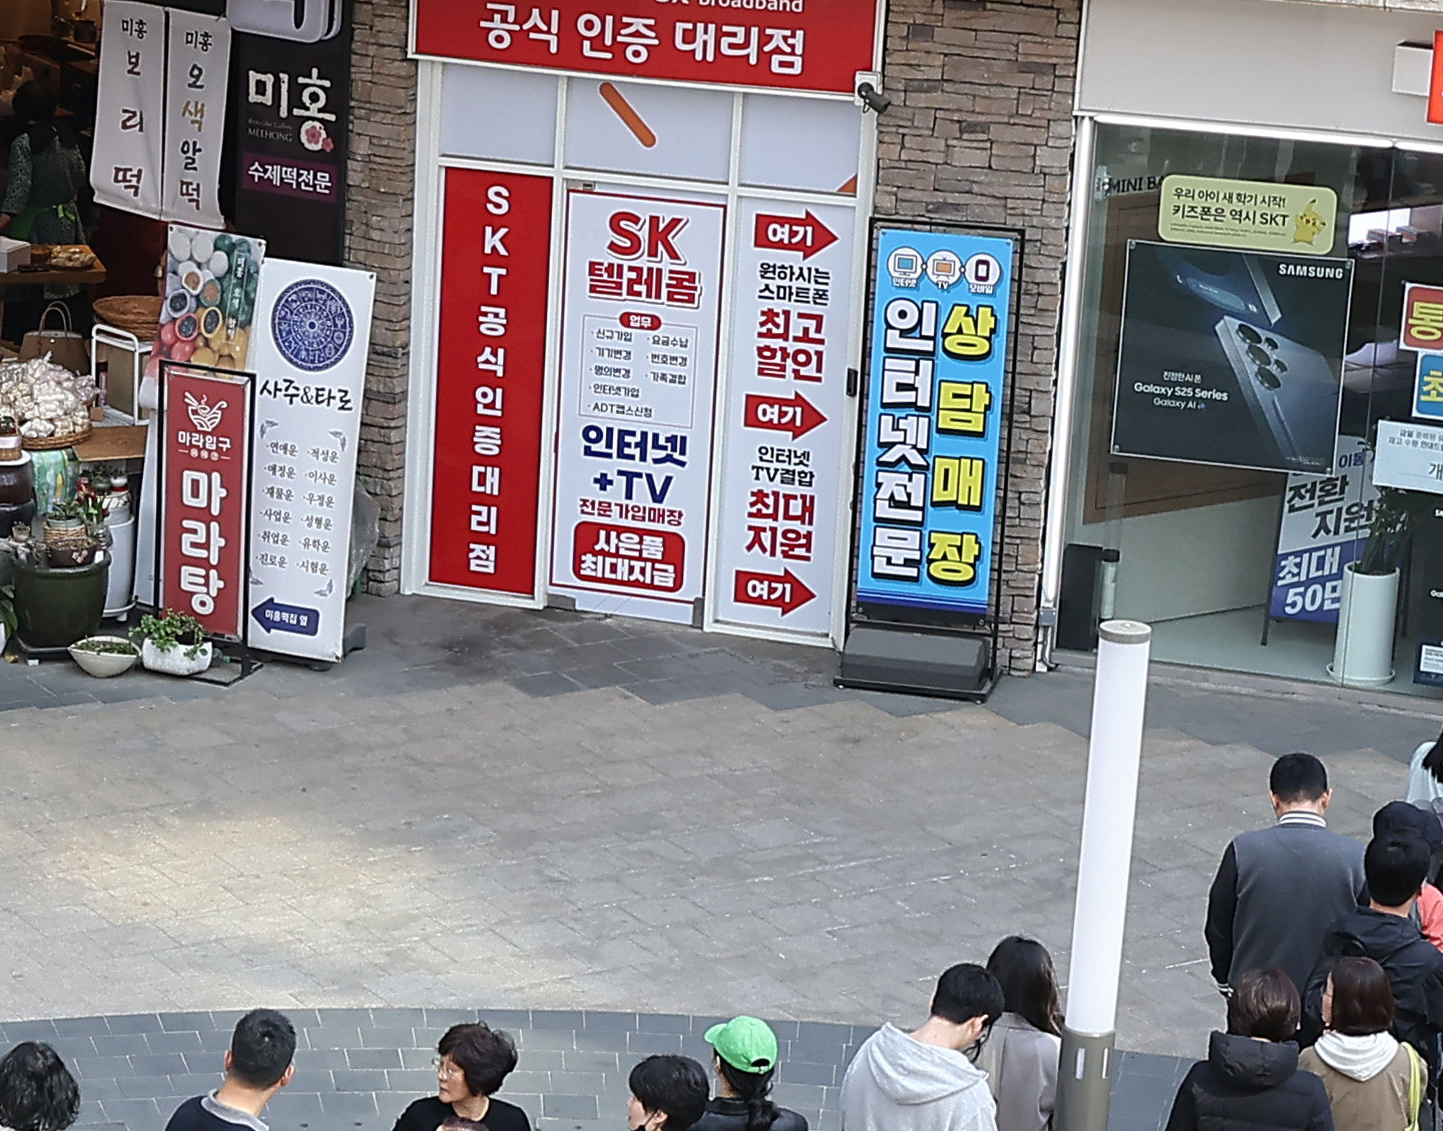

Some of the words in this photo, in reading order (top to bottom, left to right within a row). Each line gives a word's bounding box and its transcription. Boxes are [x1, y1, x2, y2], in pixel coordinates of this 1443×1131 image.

[122, 18, 147, 40] 미홍
[480, 3, 558, 54] 공식
[577, 12, 660, 64] 인증
[674, 21, 805, 75] 대리점
[185, 30, 213, 53] 미홍
[247, 67, 337, 151] 미홍
[248, 161, 333, 195] 수제떡전문
[1173, 188, 1195, 202] 우리
[1198, 190, 1219, 203] 아이
[1222, 192, 1233, 204] 새
[1236, 194, 1257, 206] 학기
[1260, 196, 1286, 208] 시작!
[1172, 204, 1226, 223] 키즈폰은
[1230, 209, 1256, 226] 역시
[1259, 214, 1289, 227] SKT
[607, 211, 688, 264] SK
[767, 223, 814, 247] 여기
[588, 261, 699, 305] 텔레콤
[759, 262, 830, 286] 원하시는
[892, 277, 916, 288] 인터넷
[1279, 263, 1344, 279] SAMSUNG
[758, 283, 829, 306] 스마트폰
[936, 281, 949, 290] TV
[630, 315, 652, 328] 업무
[757, 308, 826, 345] 최고
[596, 328, 633, 342] 신규가입
[652, 335, 689, 349] 요금수납
[595, 347, 632, 361] 기기변경
[651, 353, 688, 367] 번호변경
[756, 345, 824, 383] 할인
[594, 365, 631, 379] 명의변경
[650, 372, 687, 386] 가족결합
[260, 378, 354, 412] 사주&타로
[593, 384, 640, 398] 인터넷가입
[1134, 382, 1174, 399] Galaxy
[1175, 386, 1194, 397] S25
[1195, 388, 1229, 401] Series
[757, 404, 803, 427] 여기
[1153, 398, 1186, 410] Galaxy
[1187, 401, 1196, 409] AI
[178, 431, 231, 452] 마라입구
[582, 425, 688, 468] 인터넷
[873, 298, 939, 580] 인터넷전문
[928, 304, 996, 584] 상담매장
[758, 446, 811, 467] 인터넷
[593, 469, 674, 504] +TV
[752, 465, 815, 487] TV결합
[1286, 474, 1349, 513] 전환
[747, 489, 816, 527] 최대
[1311, 500, 1375, 539] 지원
[180, 469, 228, 616] 마라탕
[594, 529, 664, 560] 사은품
[745, 524, 813, 562] 지원
[579, 553, 676, 588] 최대지급
[1276, 546, 1342, 587] 최대
[746, 580, 792, 602] 여기
